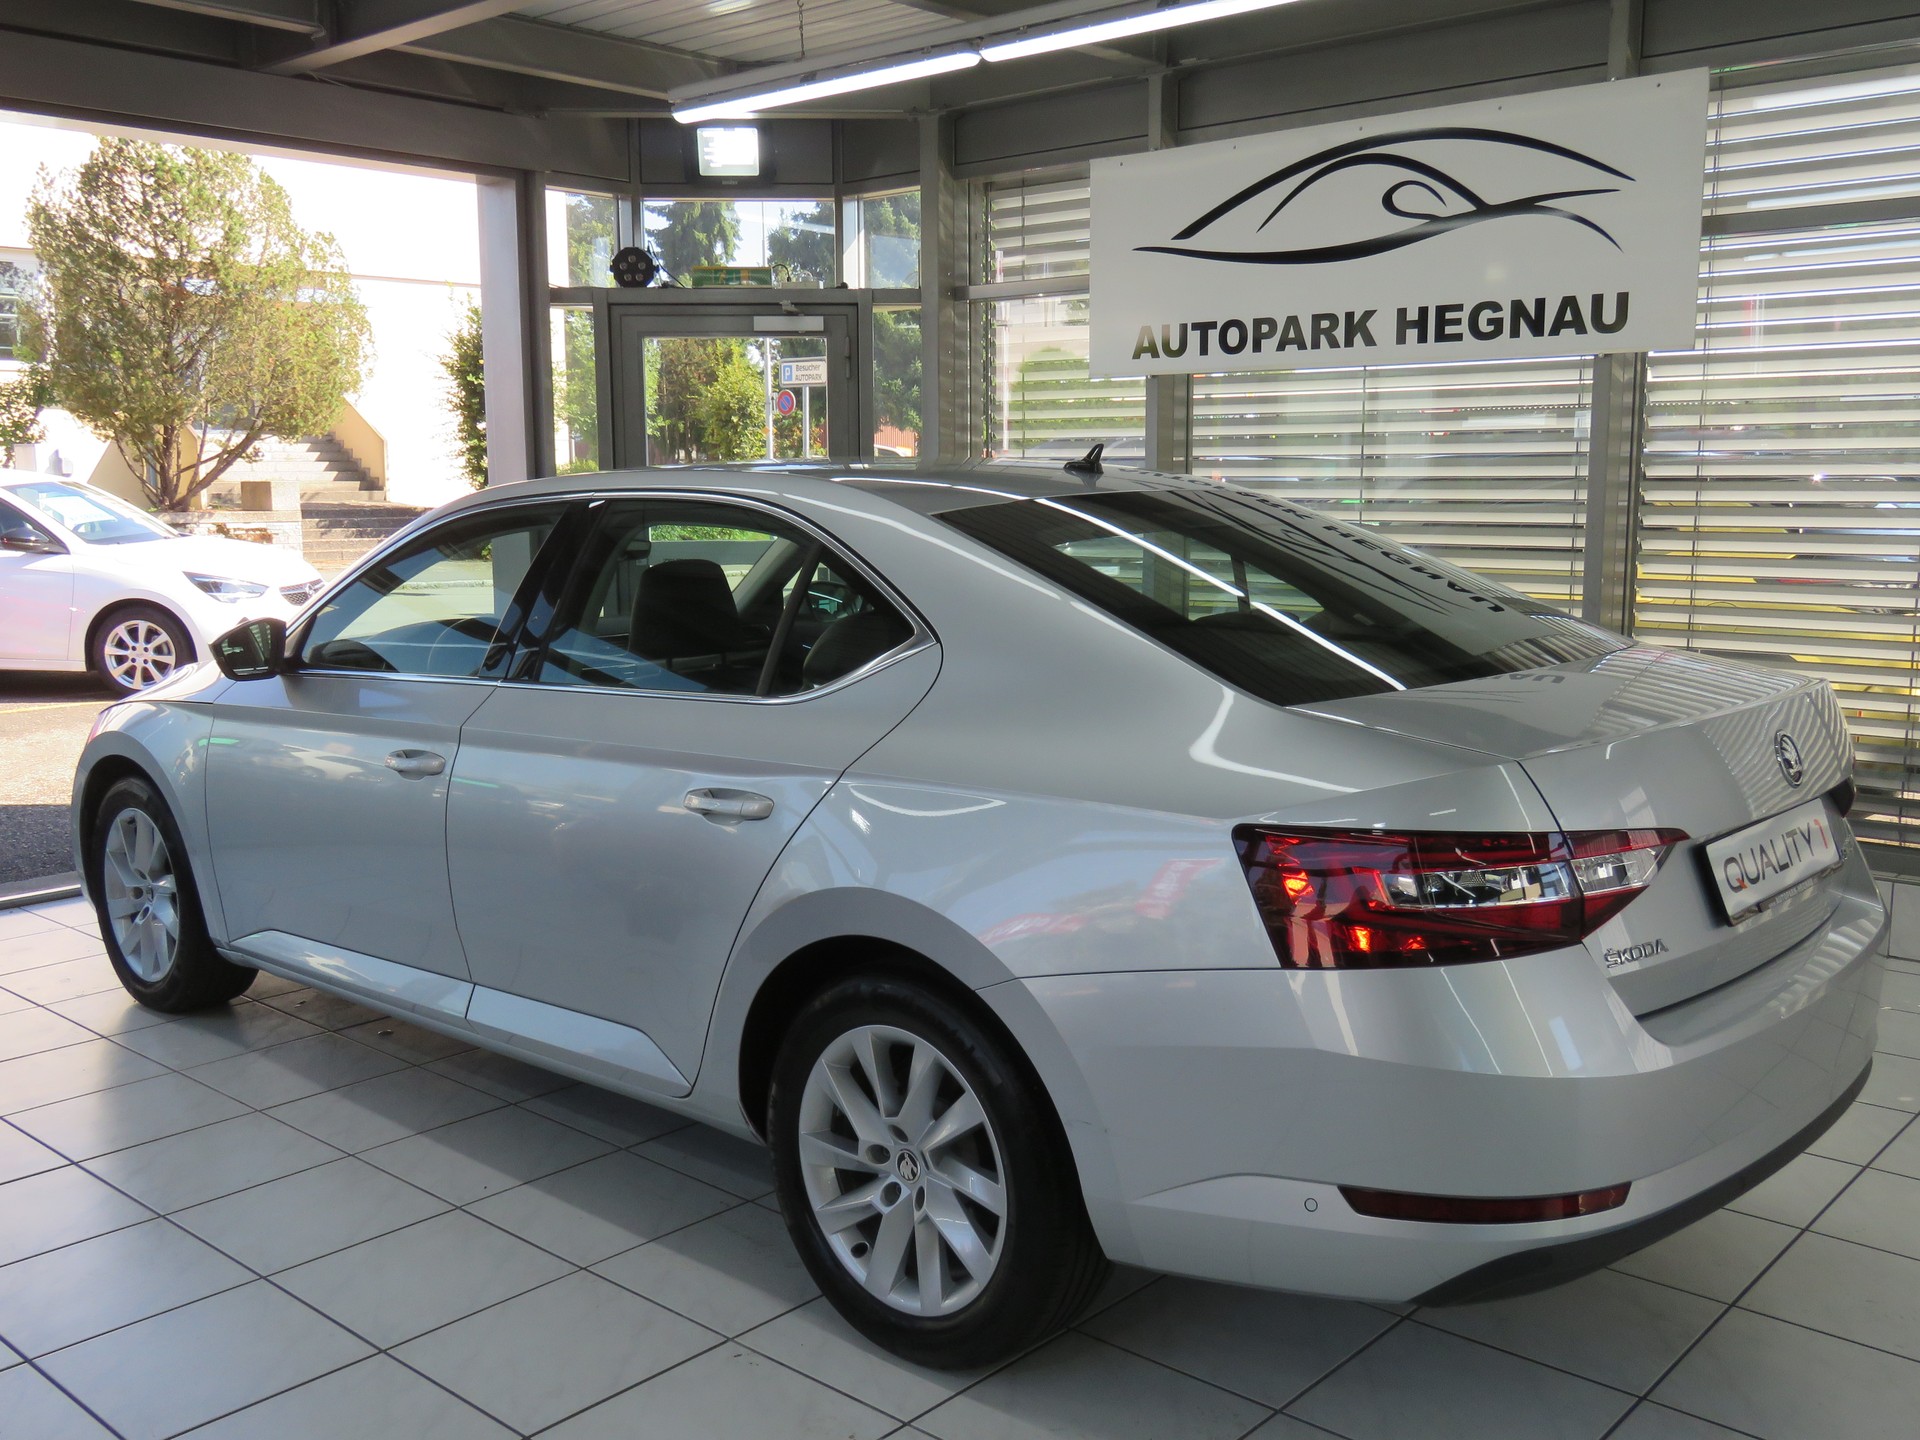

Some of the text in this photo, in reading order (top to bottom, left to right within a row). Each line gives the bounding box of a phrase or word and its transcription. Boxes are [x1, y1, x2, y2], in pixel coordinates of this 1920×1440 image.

[1132, 291, 1630, 360] AUTOPARK HEGNAU
[795, 363, 821, 371] Besucher
[794, 373, 823, 382] AUTOPARK
